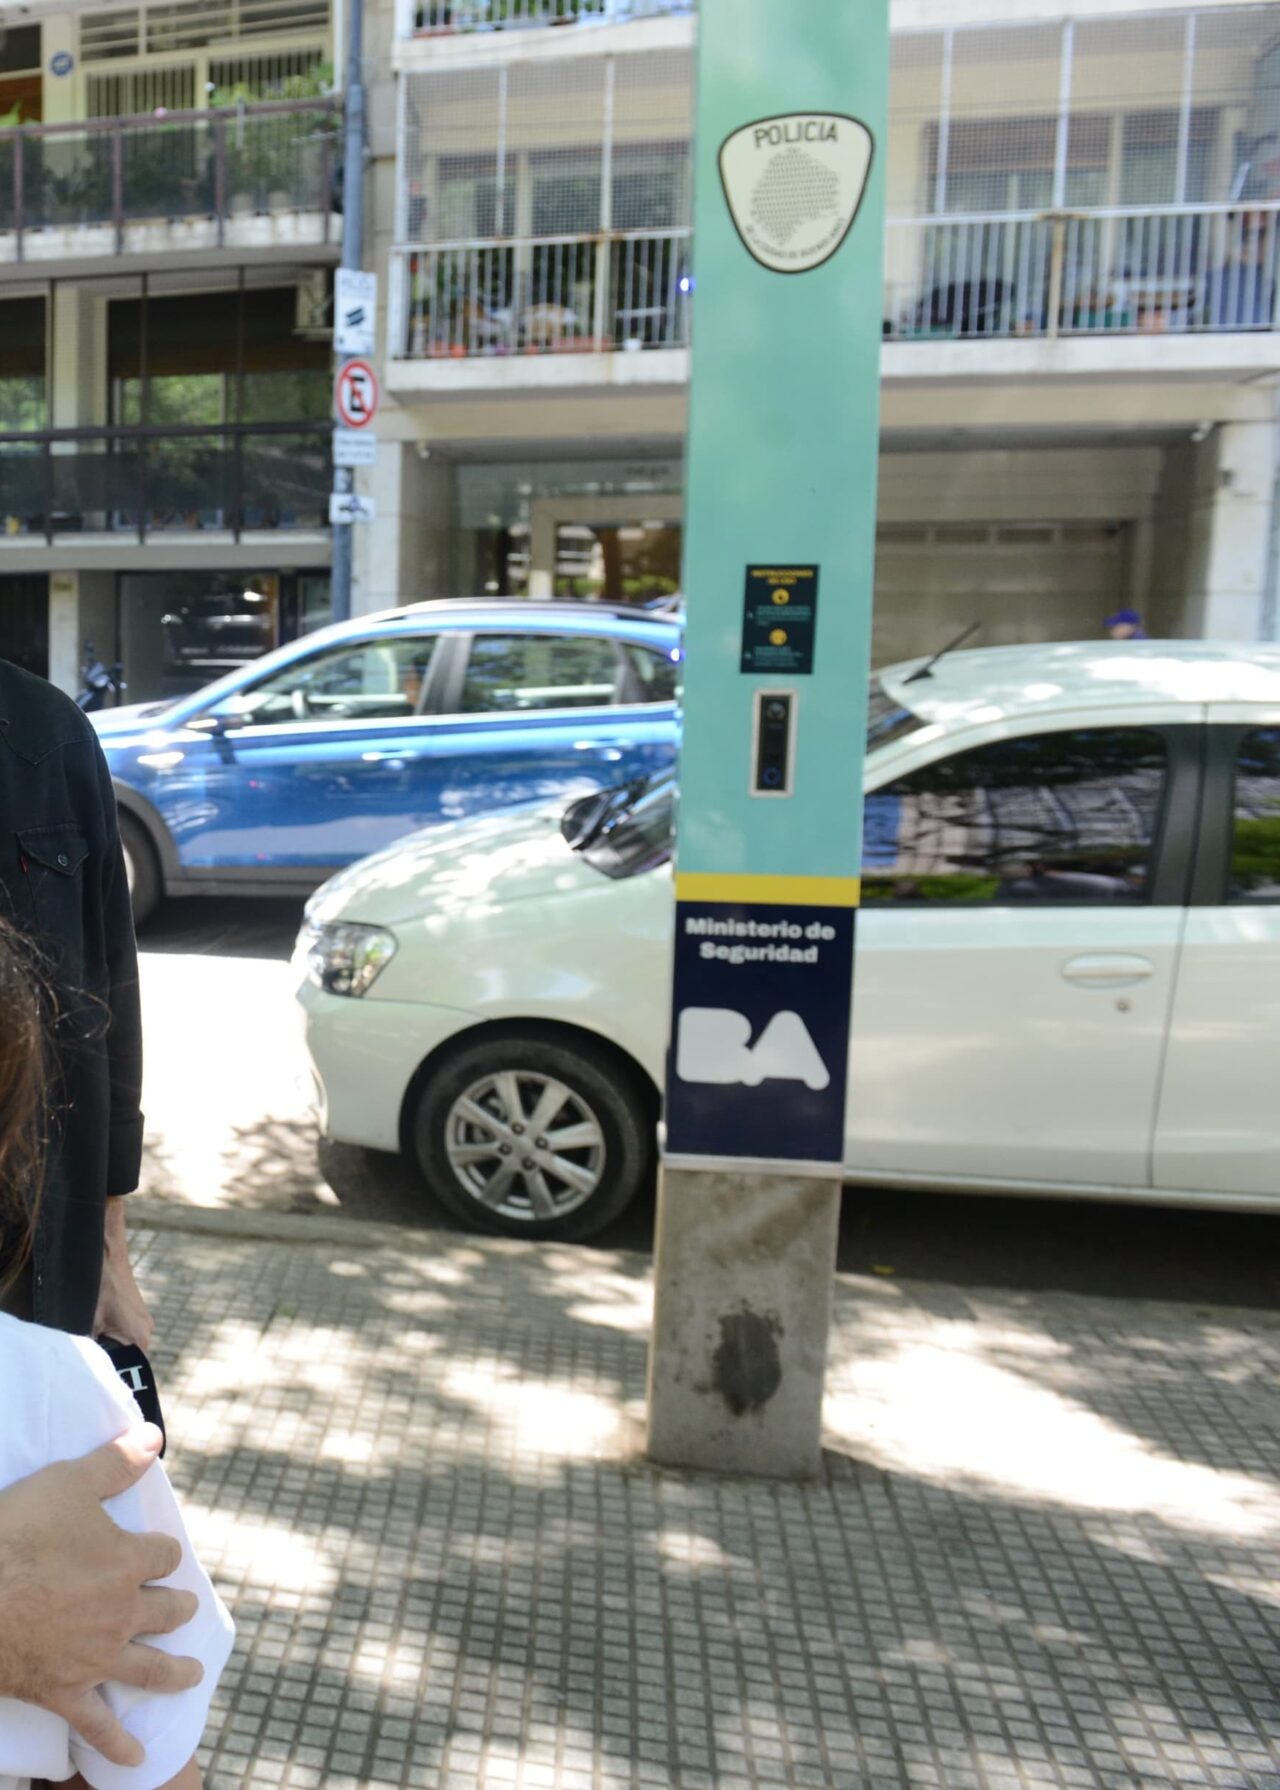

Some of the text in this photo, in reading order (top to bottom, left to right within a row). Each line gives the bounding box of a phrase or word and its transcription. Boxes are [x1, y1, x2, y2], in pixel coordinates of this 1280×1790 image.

[753, 120, 839, 149] POLICIA
[685, 917, 836, 940] Ministerio de
[699, 941, 818, 964] Seguridad
[676, 1007, 830, 1090] BA
